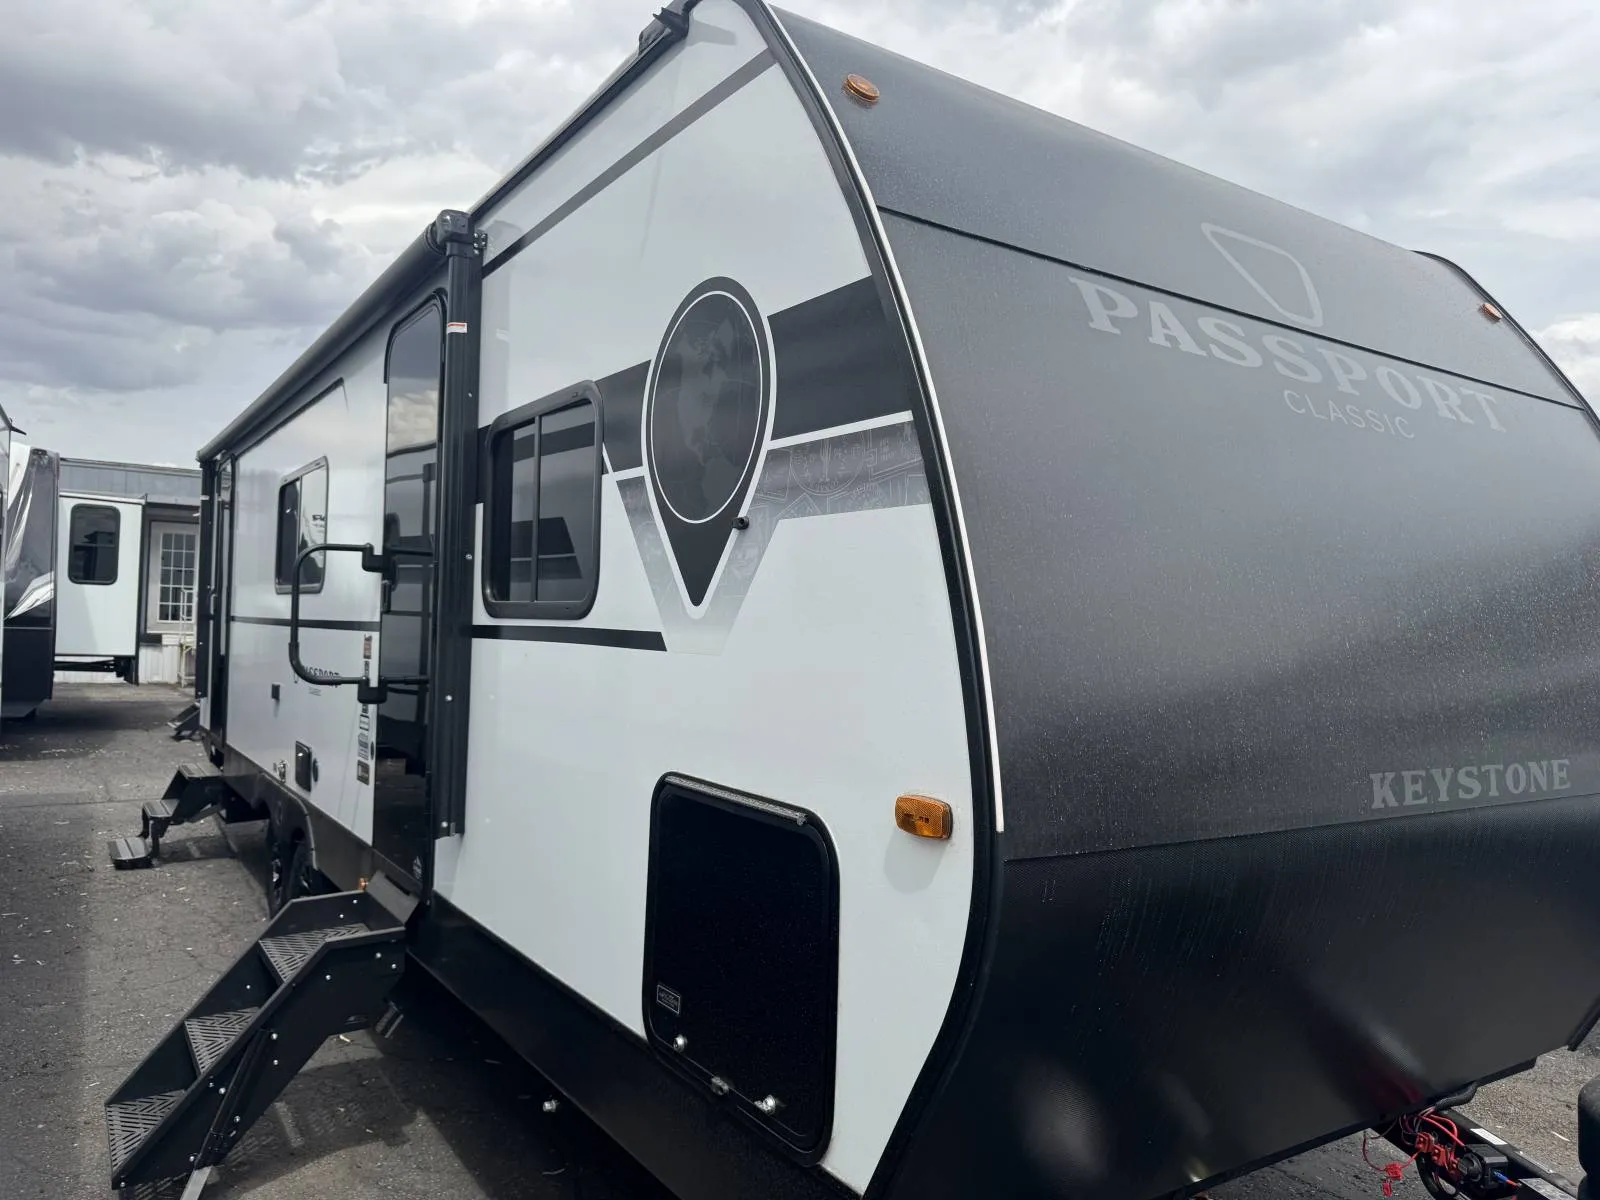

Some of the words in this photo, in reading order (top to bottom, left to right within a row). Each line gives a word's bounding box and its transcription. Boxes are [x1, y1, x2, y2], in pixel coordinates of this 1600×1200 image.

[1069, 276, 1507, 433] PASSPORT
[1283, 389, 1416, 439] CLASSIC
[1369, 758, 1572, 809] KEYSTONE
